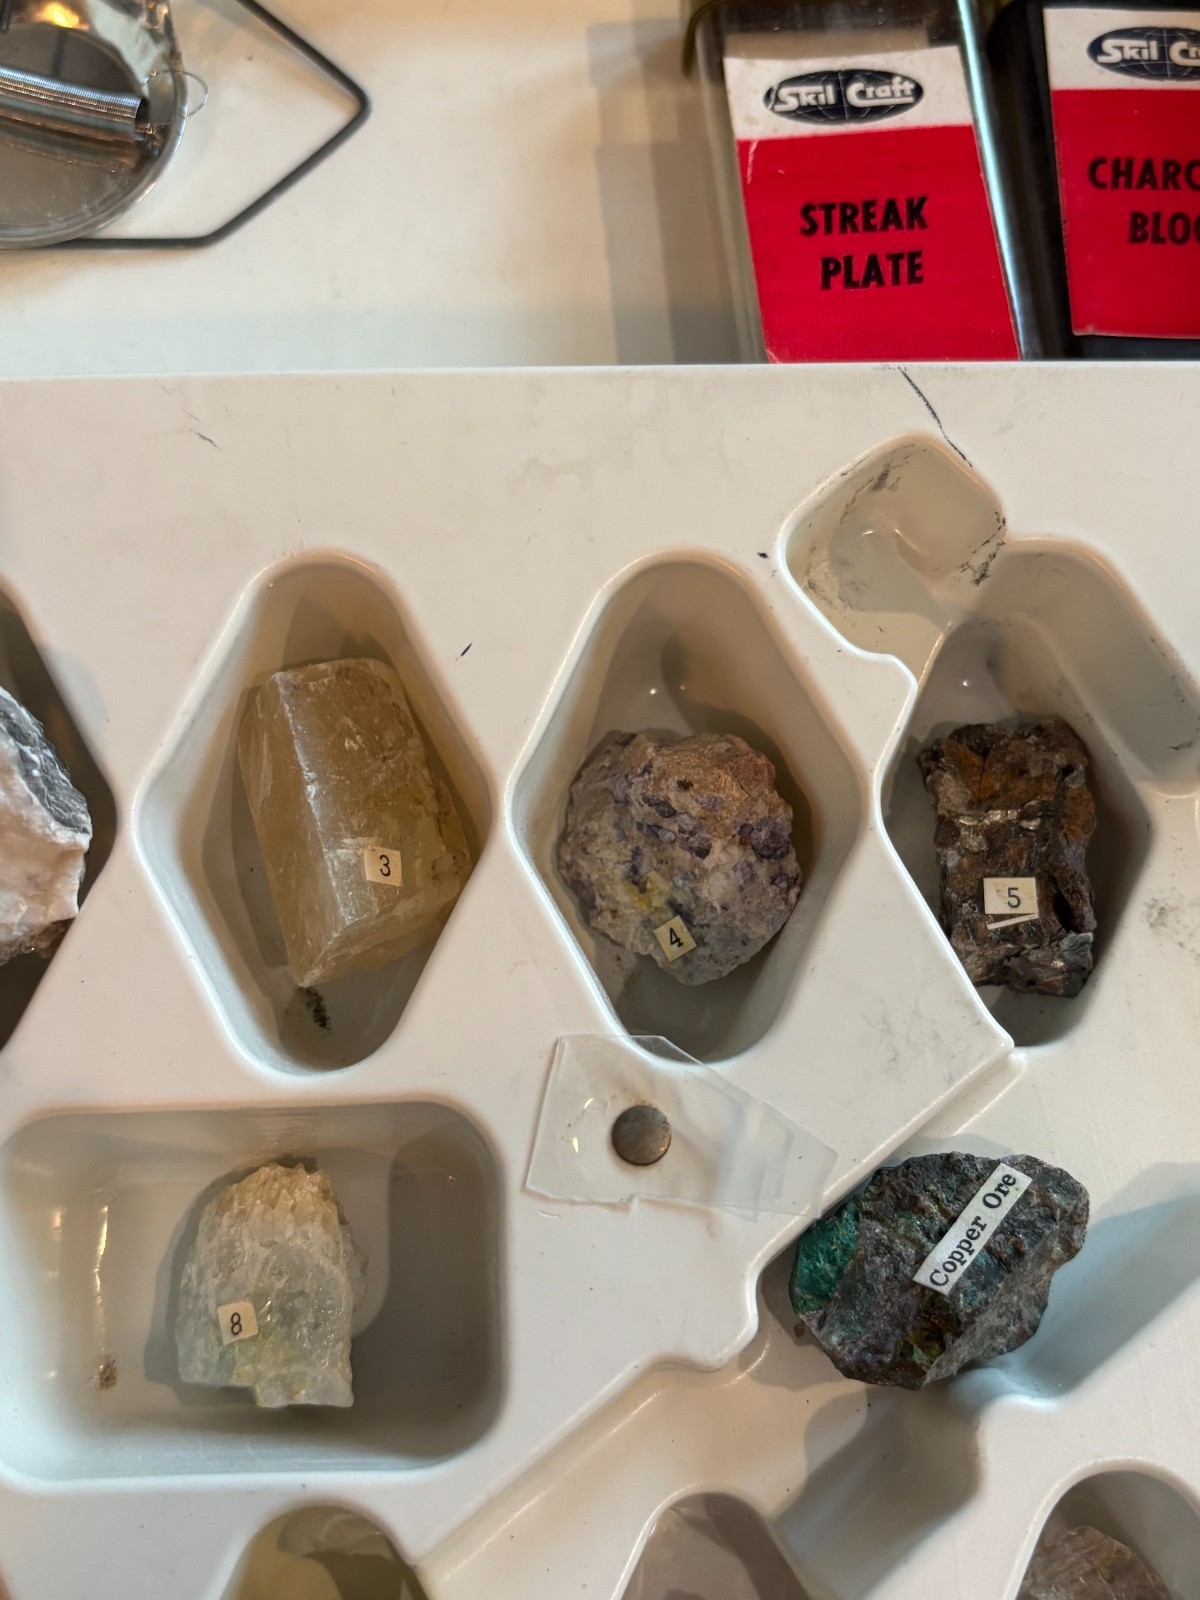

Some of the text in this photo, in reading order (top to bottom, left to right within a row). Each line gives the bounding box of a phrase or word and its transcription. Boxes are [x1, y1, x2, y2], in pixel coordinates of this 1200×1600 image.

[1097, 38, 1160, 63] Skil
[774, 76, 915, 112] Skil Craft
[799, 196, 929, 237] STREAK
[820, 249, 924, 291] PLATE
[379, 854, 391, 877] 3
[1007, 886, 1021, 909] 5
[669, 927, 684, 948] 4
[929, 1173, 1017, 1288] Copper Ore
[230, 1312, 243, 1336] 8
